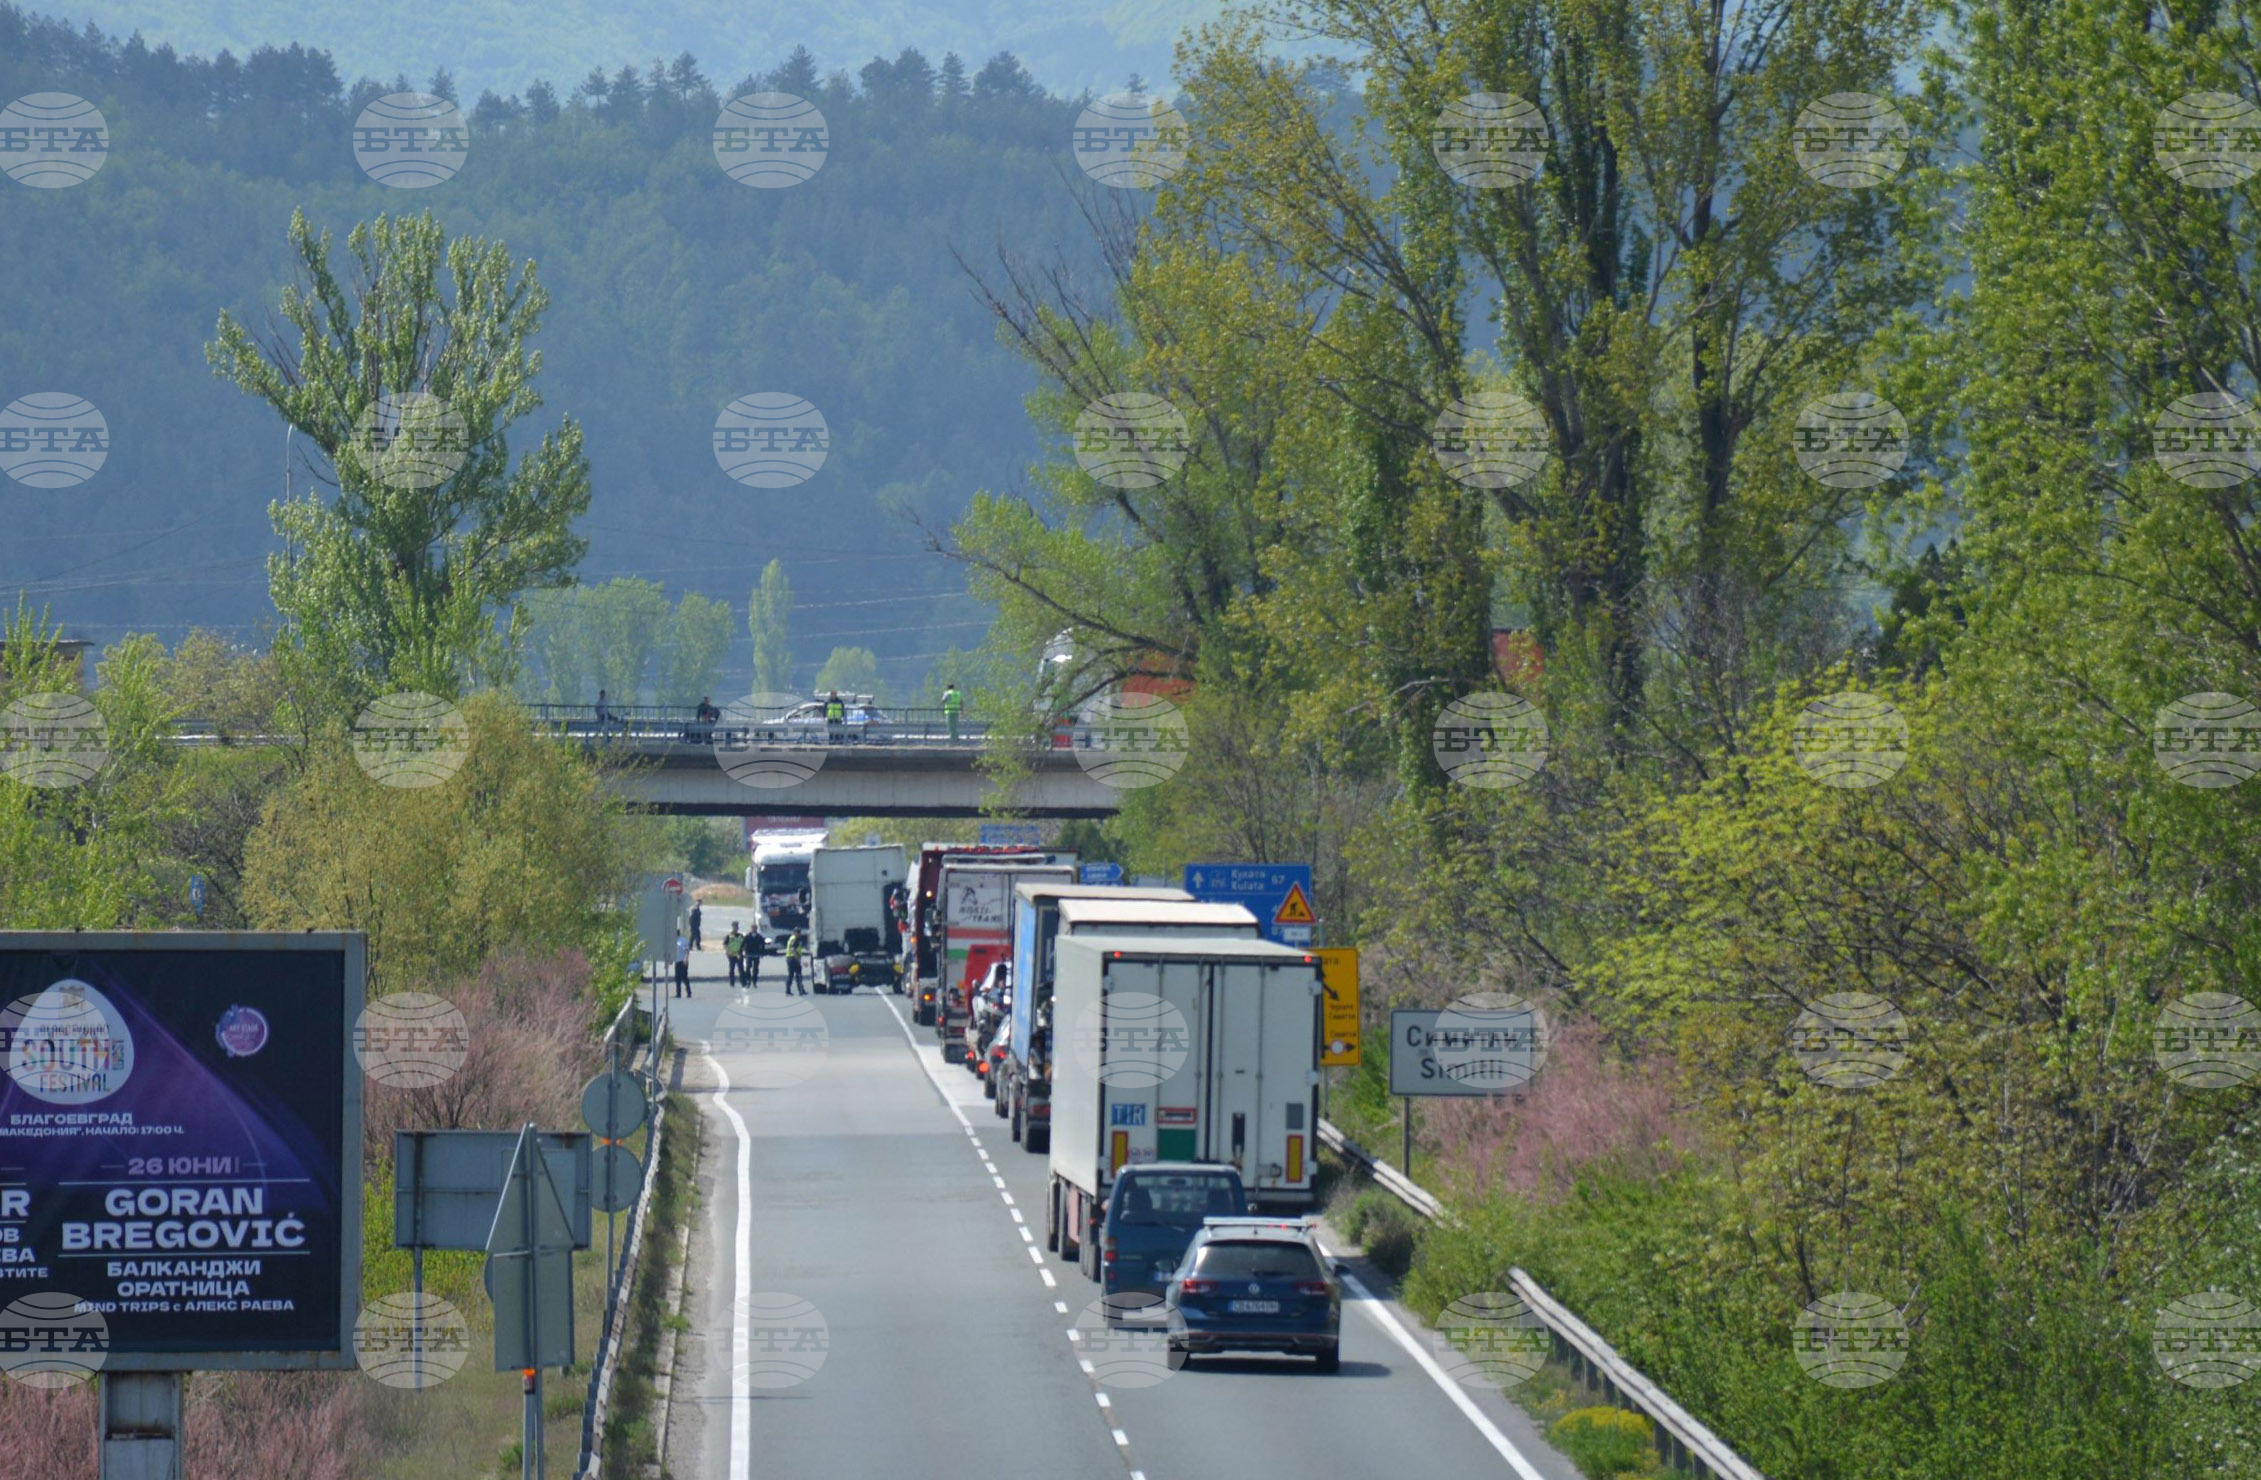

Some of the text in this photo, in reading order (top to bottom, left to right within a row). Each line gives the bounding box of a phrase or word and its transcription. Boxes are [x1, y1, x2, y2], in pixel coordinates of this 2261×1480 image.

[1231, 881, 1265, 891] Kulata
[22, 1037, 110, 1072] SOUTH
[1421, 1057, 1503, 1080] Simitli
[40, 1073, 111, 1093] FESTIVAL
[10, 1112, 133, 1126] БЛАГОЕВГРАД
[1113, 1104, 1144, 1125] TIR
[140, 1125, 172, 1135] 17:00
[128, 1157, 163, 1175] 26
[104, 1187, 263, 1217] GORAN
[62, 1212, 306, 1250] BREGOVIĆ
[107, 1260, 261, 1279] БАЛКАНДЖИ
[117, 1281, 250, 1298] ОРАТНИЦА
[74, 1302, 117, 1313] MIND
[119, 1301, 170, 1312] TRIPS
[184, 1301, 238, 1312] АЛЕКС
[240, 1300, 295, 1311] РАЕВА
